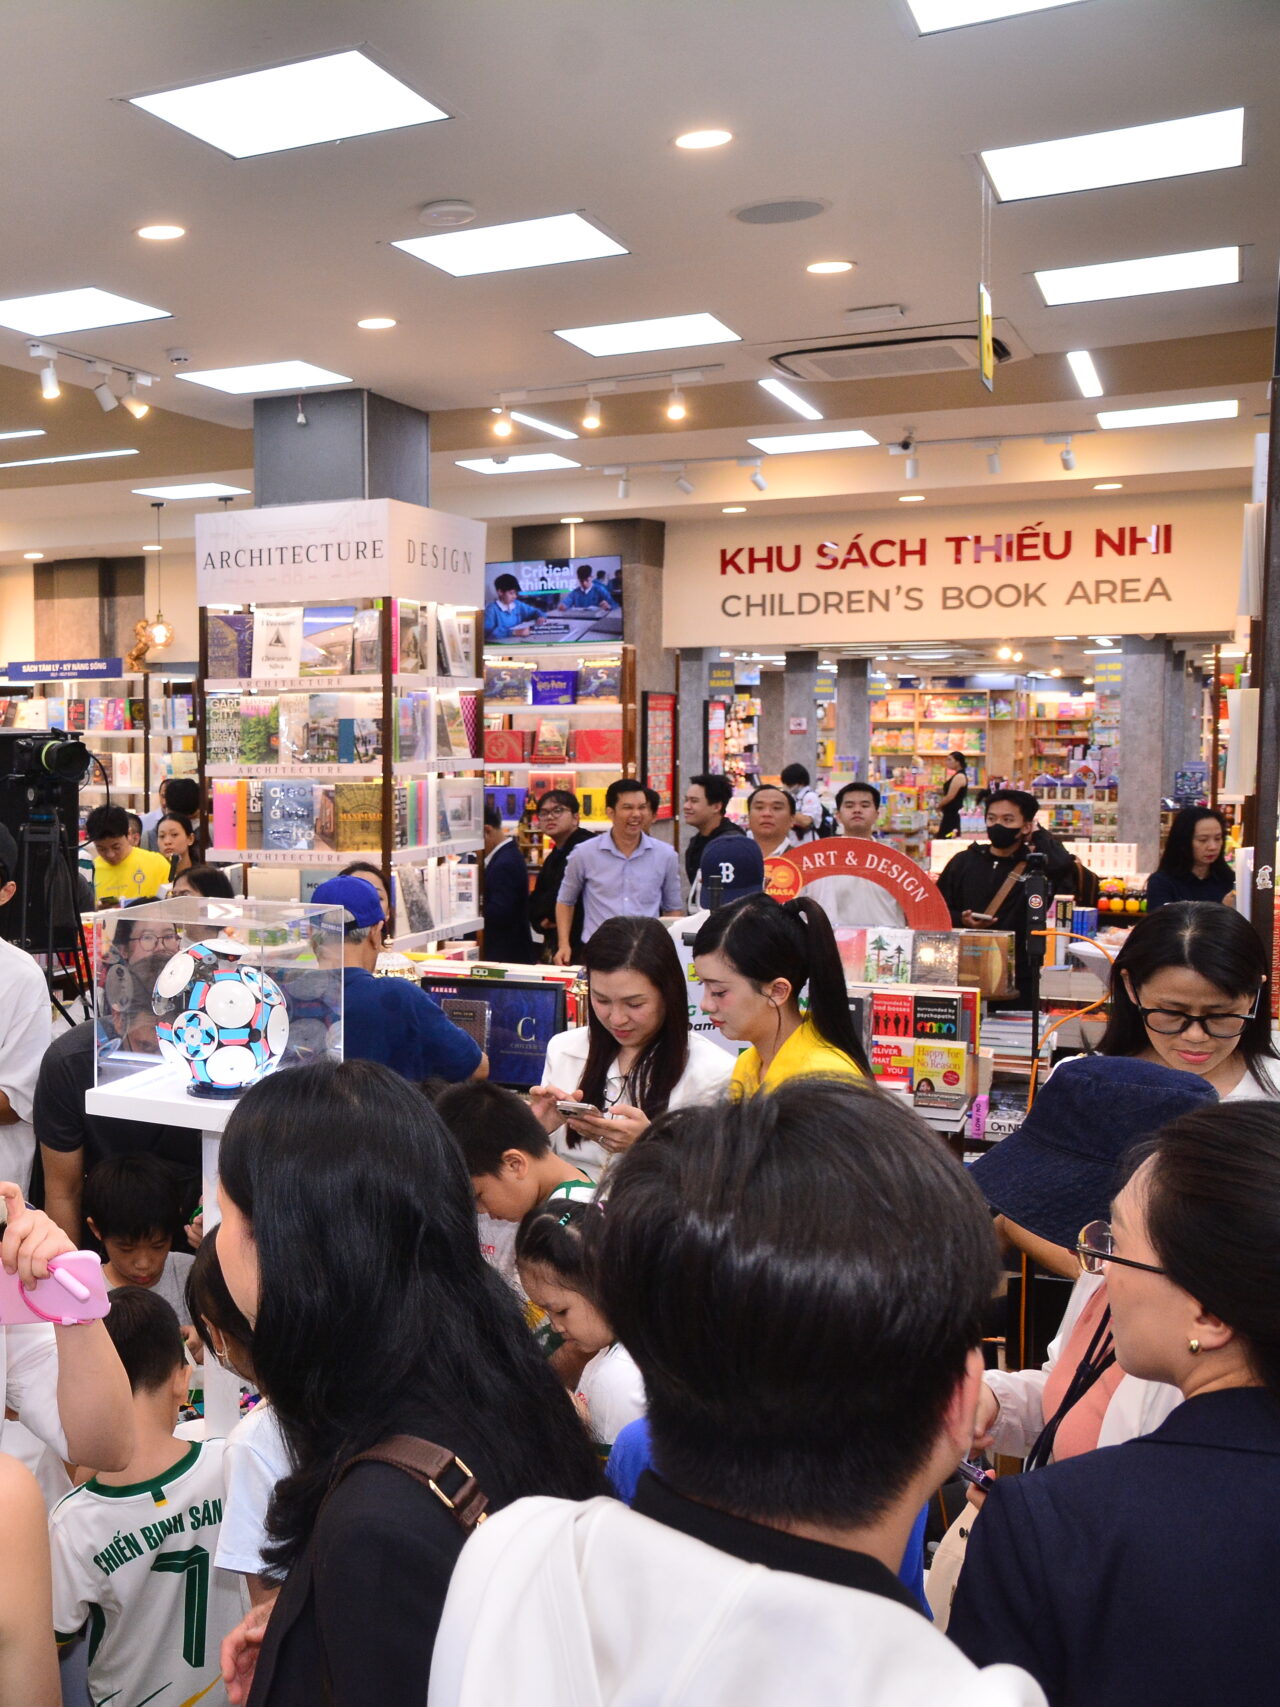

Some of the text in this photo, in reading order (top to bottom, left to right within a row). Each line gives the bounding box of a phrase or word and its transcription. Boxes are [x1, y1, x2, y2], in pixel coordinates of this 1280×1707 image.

[720, 521, 1172, 576] KHU SÁCH THIẾU NHI
[203, 539, 473, 575] ARCHITECTURE DESIGN
[521, 564, 574, 578] Critical
[520, 577, 577, 592] thinking
[721, 577, 1172, 618] CHILDREN’S BOOK AREA
[237, 678, 343, 688] ARCHITECTURE
[238, 766, 343, 775] ARCHITECTURE
[238, 852, 342, 862] ARCHITECTURE
[719, 862, 735, 884] B
[801, 850, 929, 903] ART & DESIGN
[766, 888, 795, 896] AHASA
[517, 1017, 536, 1042] C
[917, 1046, 961, 1061] Happy for
[930, 1059, 961, 1070] Reason
[991, 1122, 1006, 1132] On
[93, 1498, 223, 1577] CHIẾN BINH SÂN
[150, 1544, 210, 1668] 7
